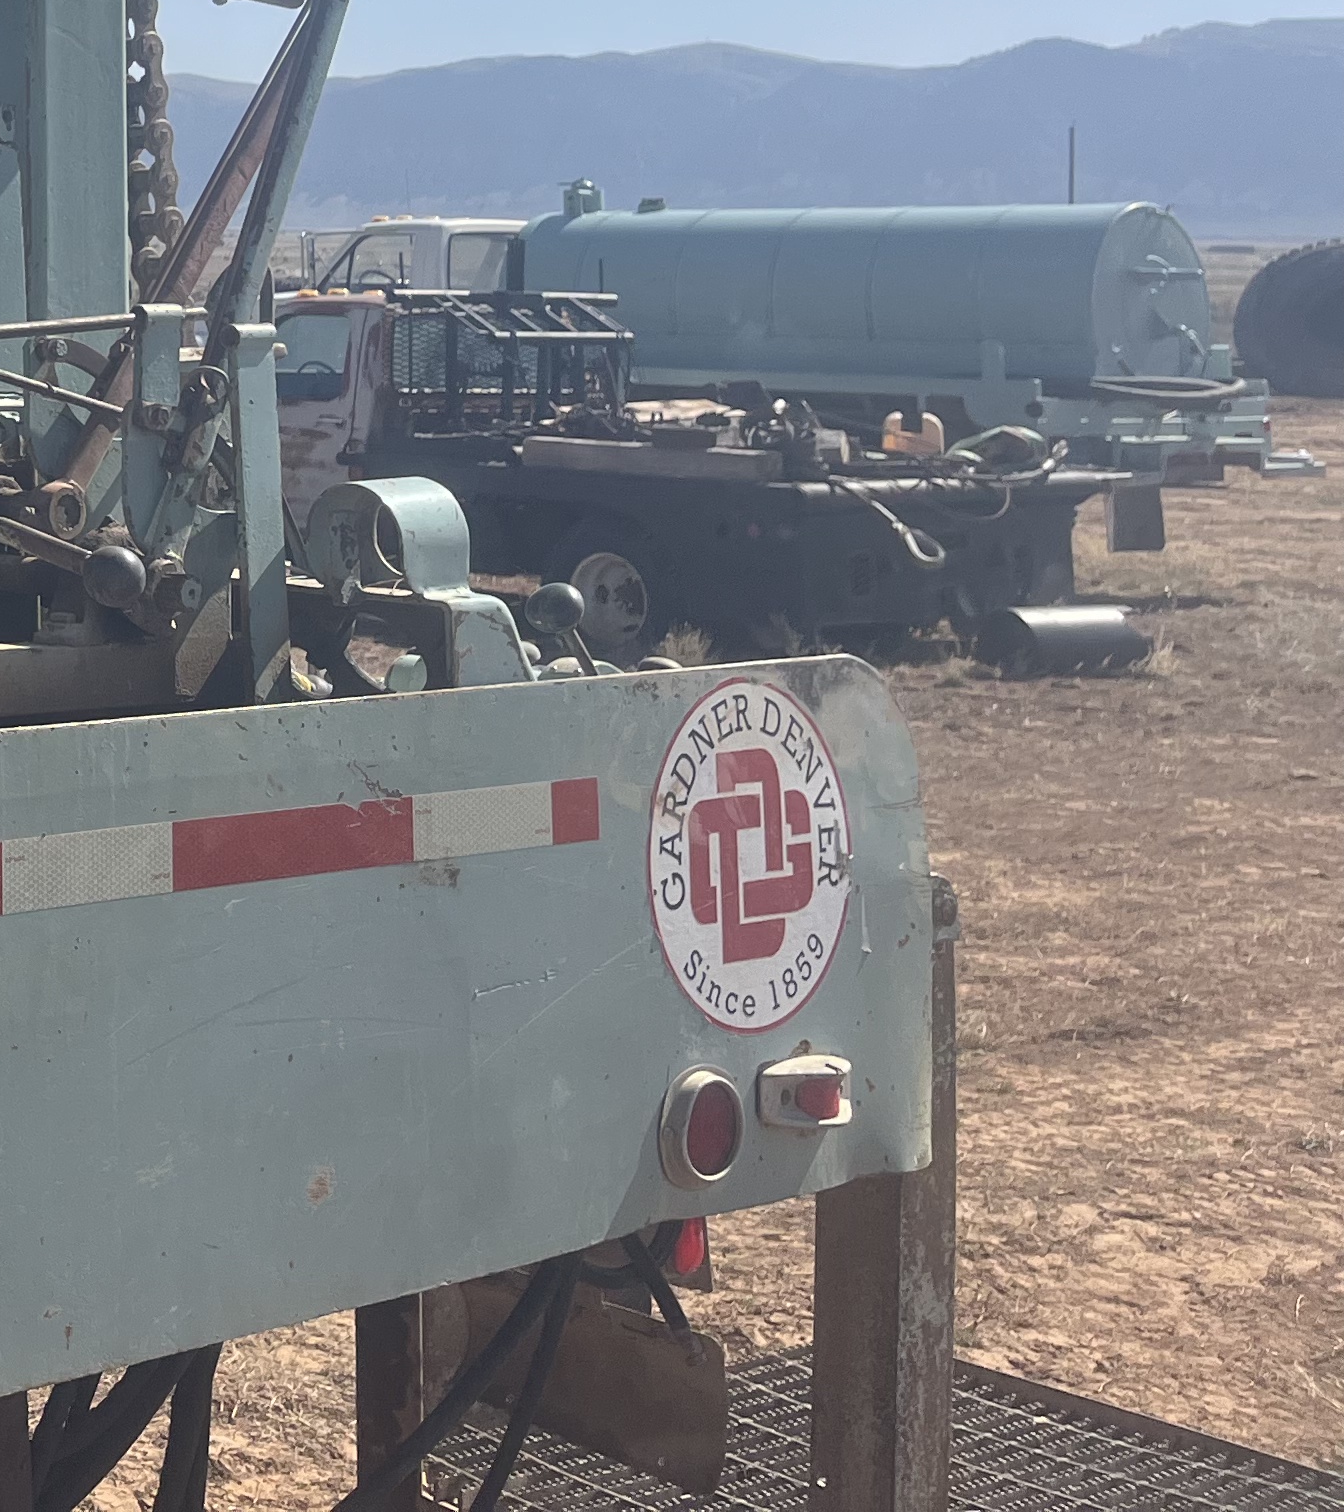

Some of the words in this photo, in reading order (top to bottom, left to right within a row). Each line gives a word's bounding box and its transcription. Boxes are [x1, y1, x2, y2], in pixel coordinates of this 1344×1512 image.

[660, 694, 752, 910] GARDNER
[760, 696, 837, 887] DENVER
[683, 949, 756, 1017] Since
[768, 933, 824, 1010] 1859
